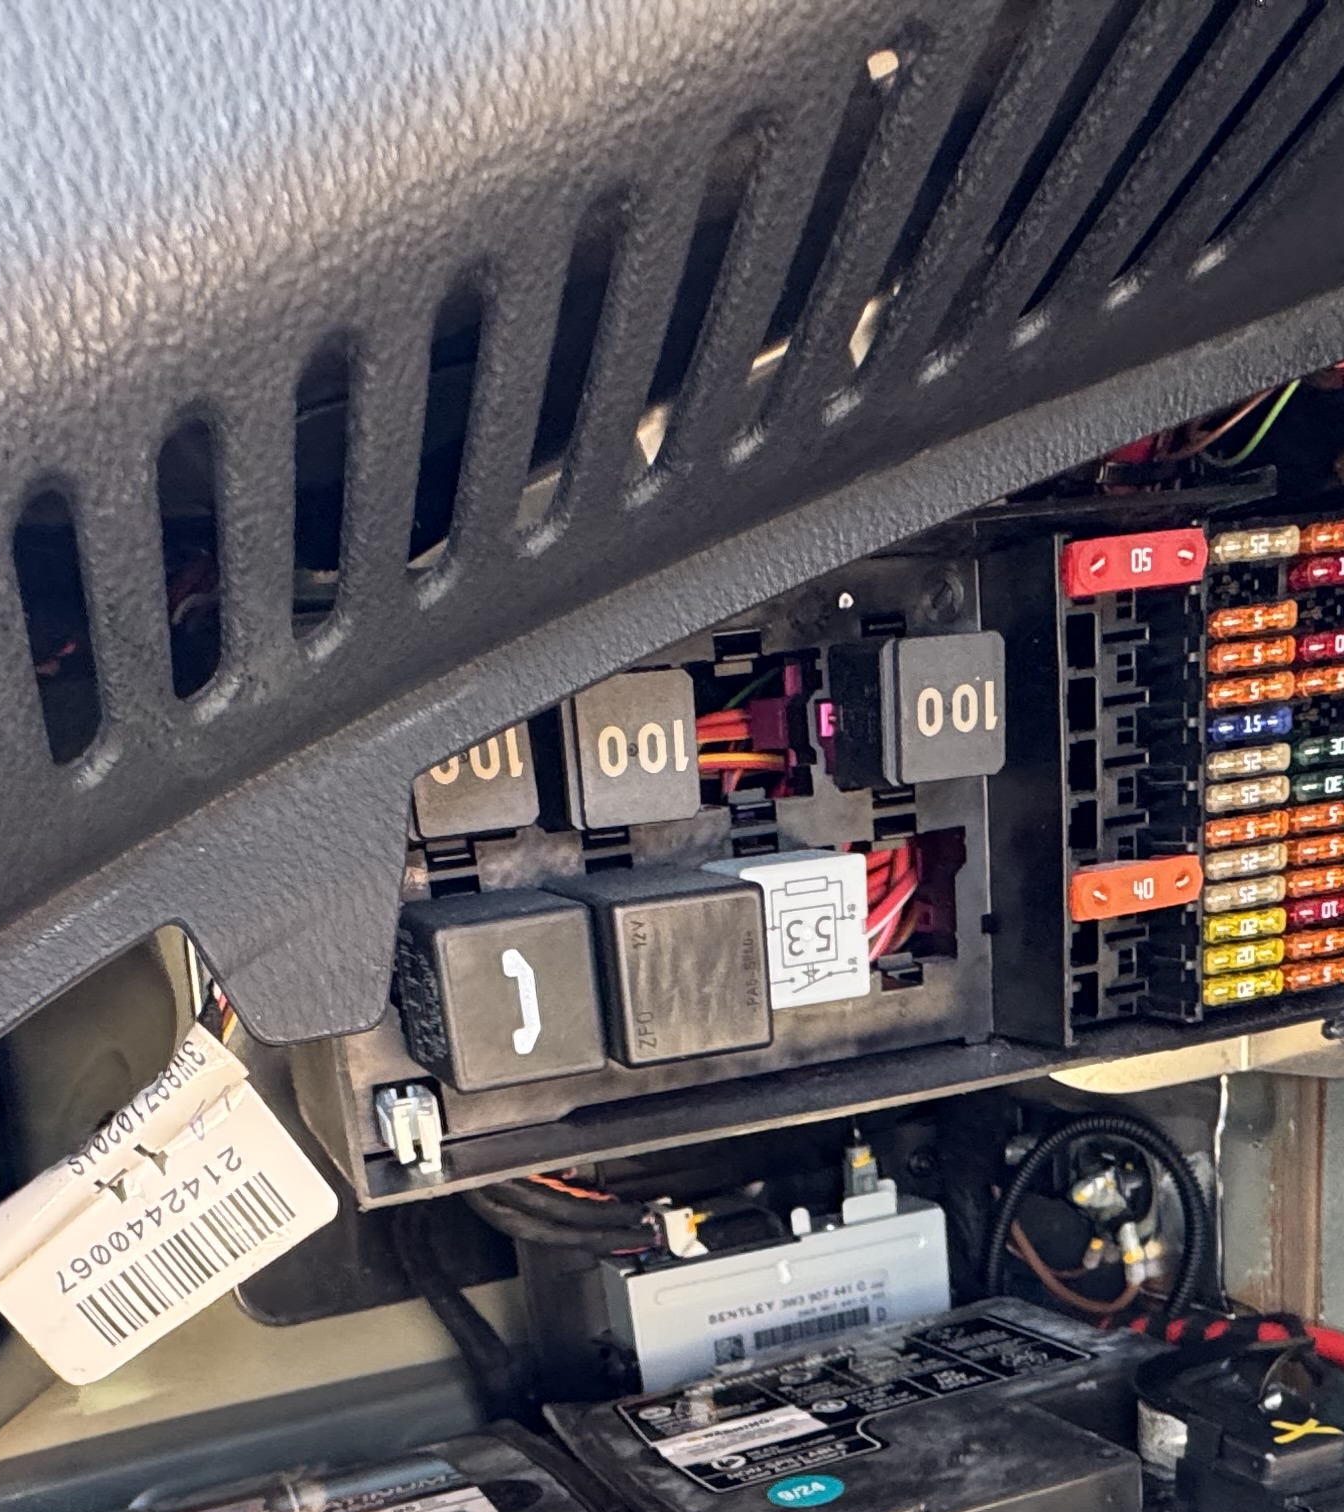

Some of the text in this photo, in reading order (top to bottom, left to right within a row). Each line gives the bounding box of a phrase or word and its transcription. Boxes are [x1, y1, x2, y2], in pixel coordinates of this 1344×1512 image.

[1130, 548, 1153, 573] 50
[1253, 610, 1263, 628] 5
[1253, 645, 1263, 663] 5
[1249, 681, 1259, 699] 5
[917, 680, 998, 737] 100
[1243, 715, 1261, 733] 15
[598, 720, 689, 777] 100
[1323, 775, 1342, 793] 30
[1328, 804, 1338, 823] 5
[1246, 820, 1256, 839] 5
[1328, 838, 1339, 856] 5
[1325, 870, 1336, 888] 5
[1132, 878, 1154, 900] 40
[1321, 901, 1338, 919] 10
[631, 920, 647, 949] 12V
[786, 915, 832, 957] 53
[1325, 932, 1335, 951] 5
[1321, 964, 1332, 983] 5
[57, 1146, 242, 1294] 2142440067
[709, 1301, 774, 1325] BENTLEY
